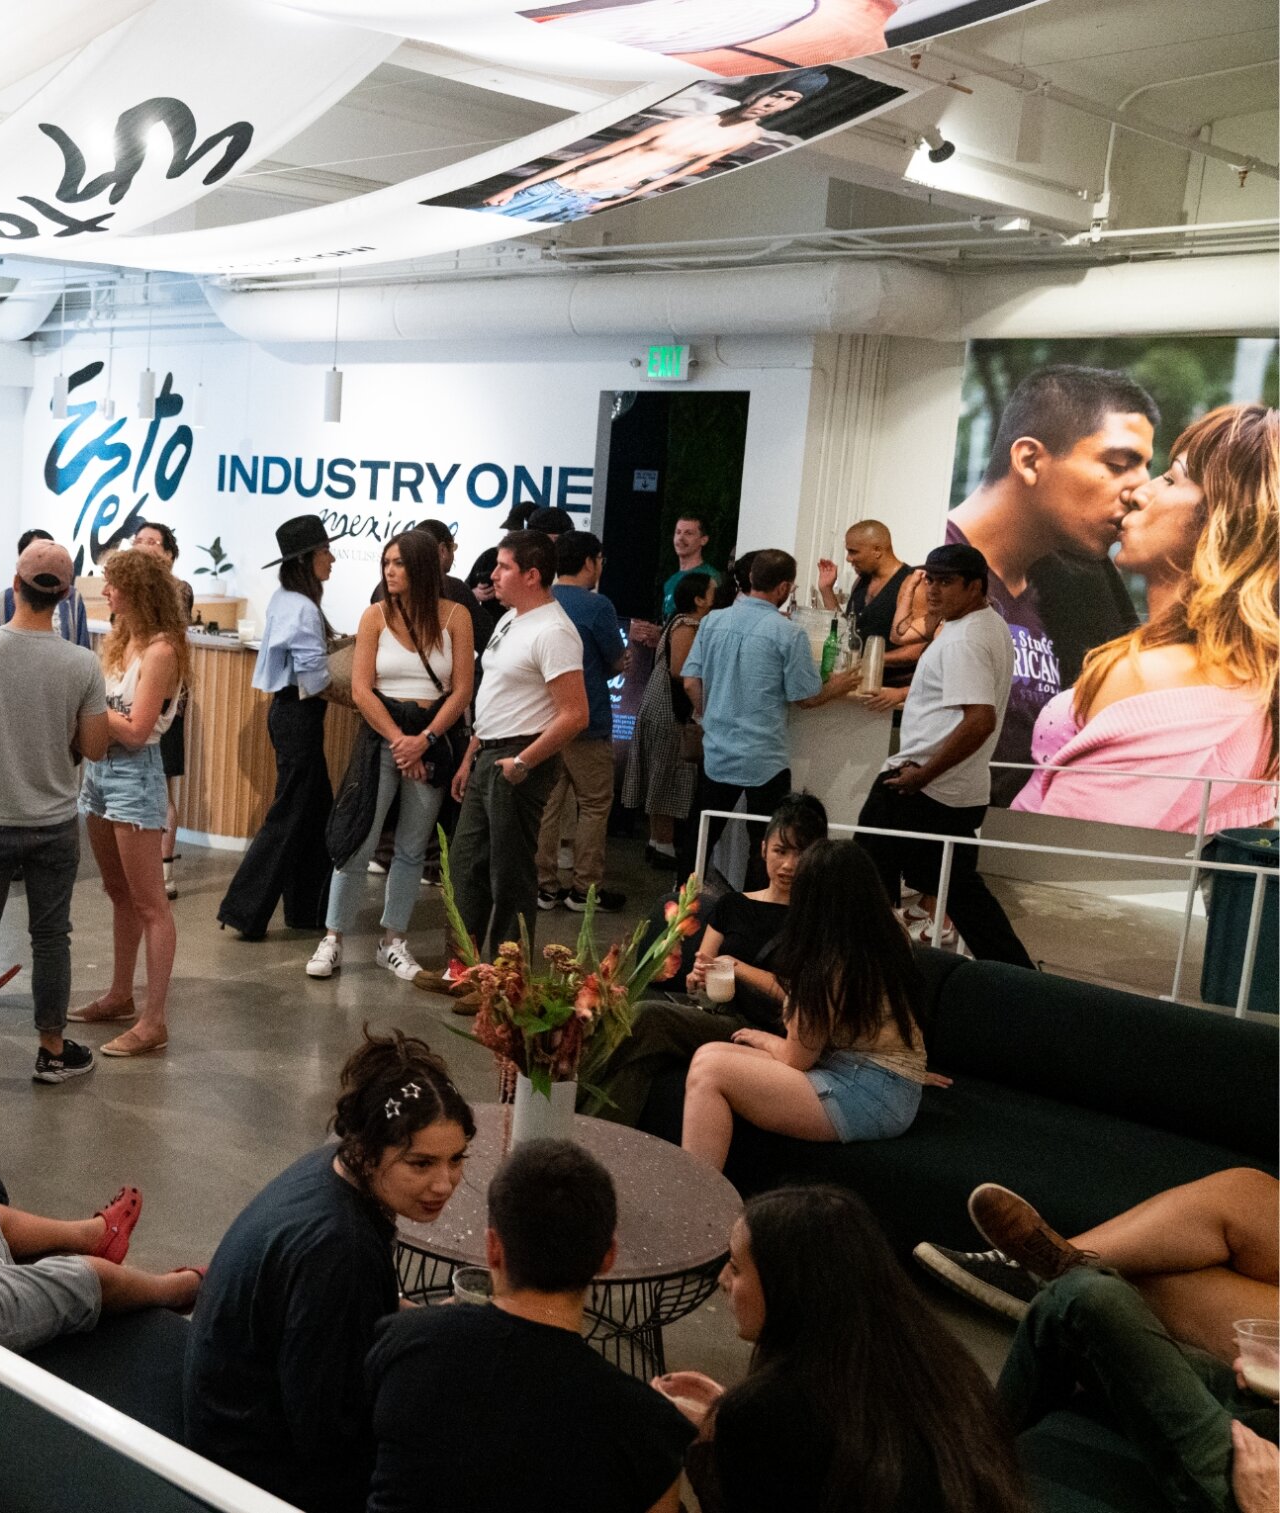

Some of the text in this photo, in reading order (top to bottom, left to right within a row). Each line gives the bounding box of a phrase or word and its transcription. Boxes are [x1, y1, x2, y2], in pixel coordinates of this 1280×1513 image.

[647, 345, 684, 378] EXIT
[217, 453, 595, 514] INDUSTRY ONE
[1012, 646, 1061, 687] RICAN
